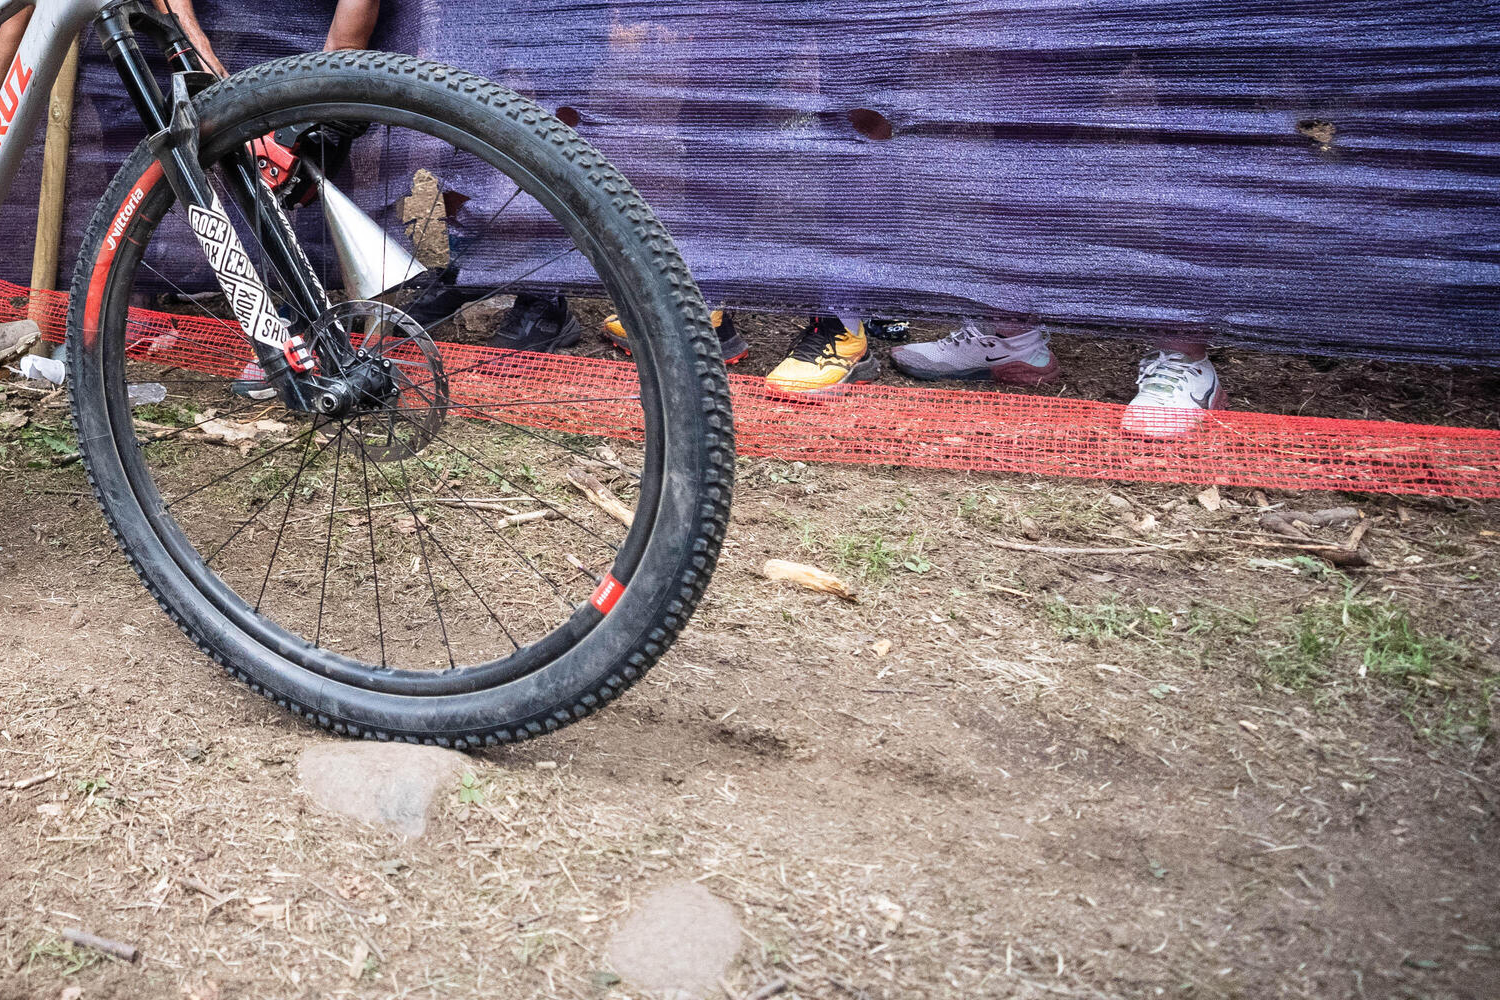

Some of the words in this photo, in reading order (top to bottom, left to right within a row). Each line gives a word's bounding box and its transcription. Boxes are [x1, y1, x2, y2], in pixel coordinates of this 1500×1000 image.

[111, 187, 144, 237] vittoria
[191, 213, 228, 244] ROCK
[261, 318, 288, 343] SHO
